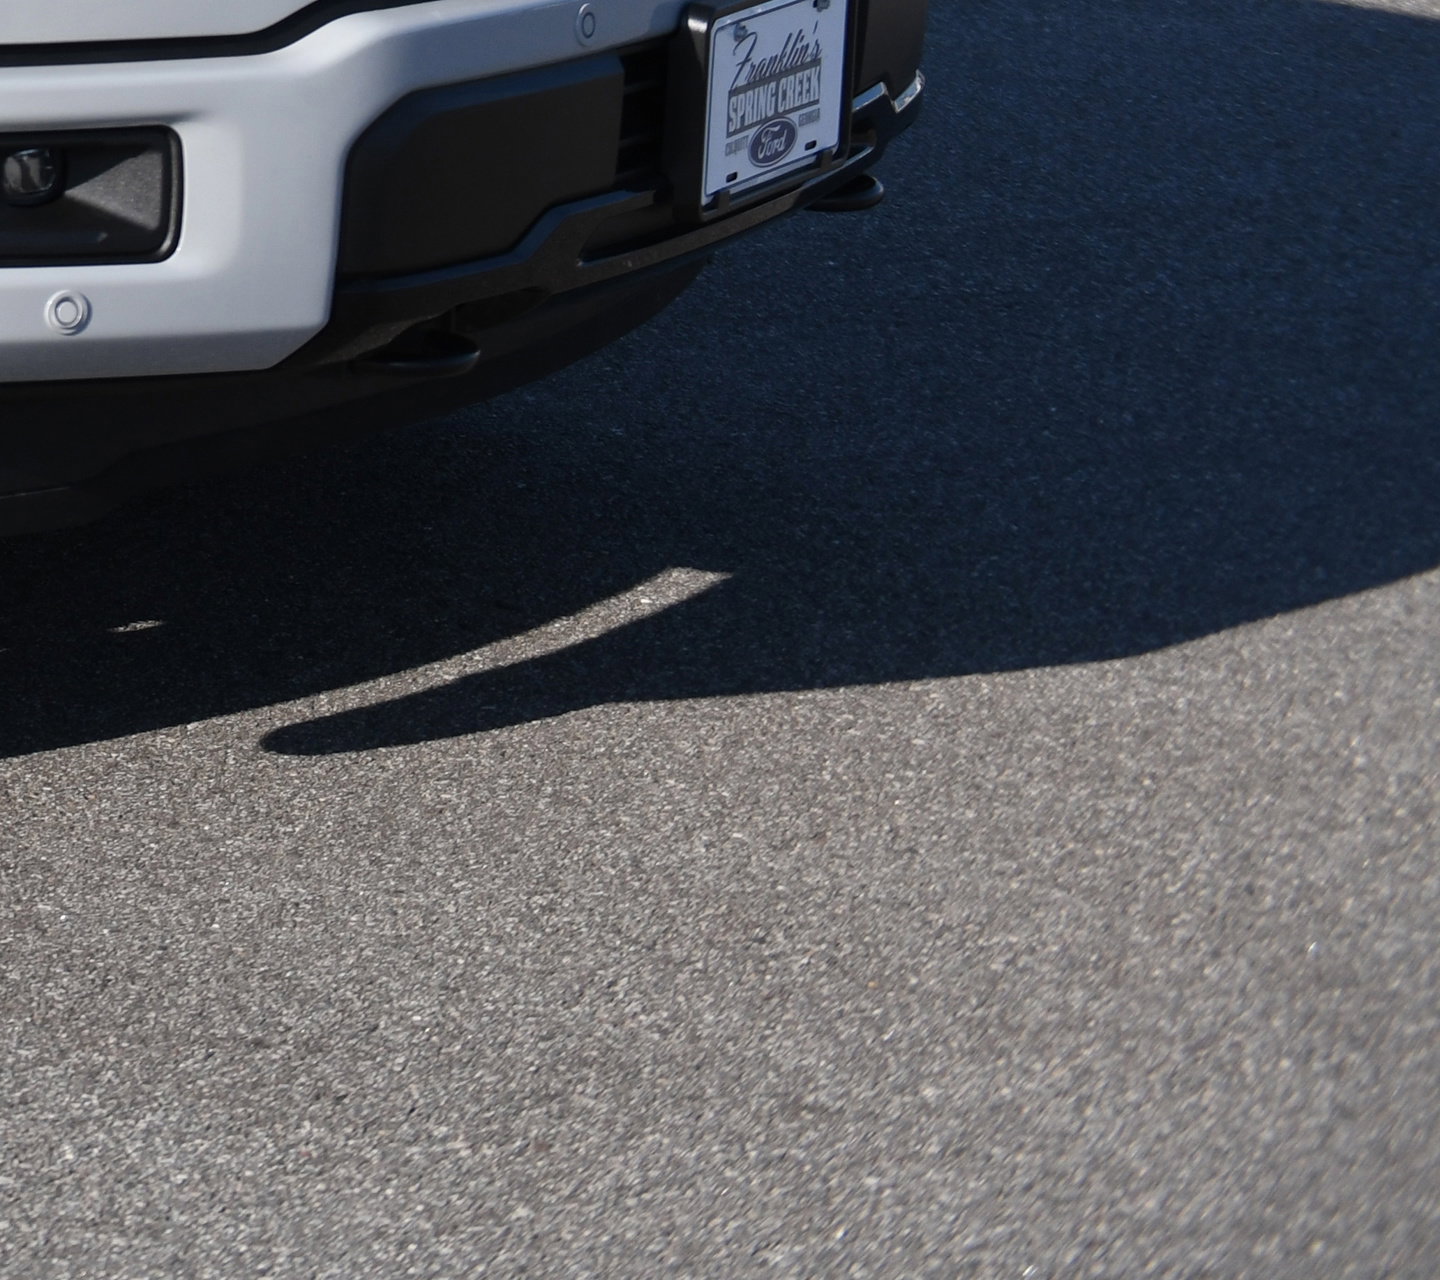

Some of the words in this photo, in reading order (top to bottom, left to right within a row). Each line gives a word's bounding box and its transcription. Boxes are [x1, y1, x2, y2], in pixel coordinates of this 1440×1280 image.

[730, 19, 823, 88] Franklin's
[728, 80, 777, 133] SPRING
[778, 65, 821, 114] CREEK
[757, 124, 788, 160] Ford
